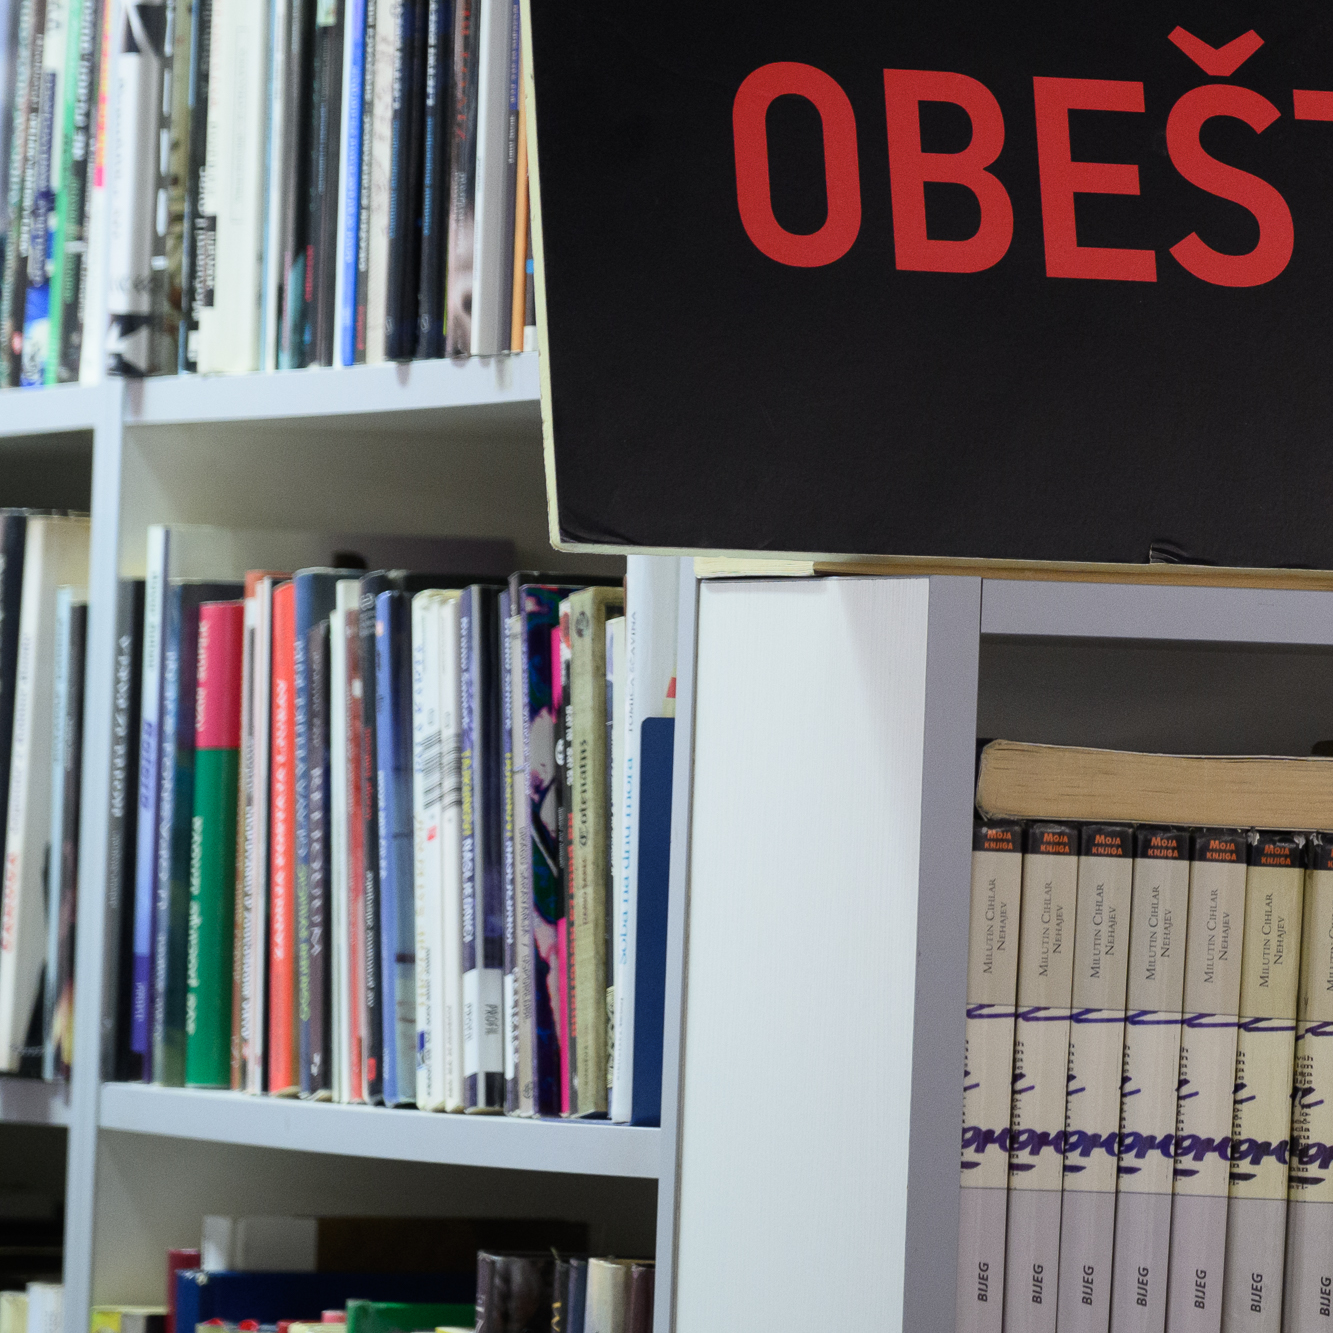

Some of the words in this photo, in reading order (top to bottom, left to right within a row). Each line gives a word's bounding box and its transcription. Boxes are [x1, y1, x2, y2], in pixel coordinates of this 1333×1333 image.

[984, 840, 1013, 850] KNJIGA
[1040, 843, 1070, 853] KNJIGA
[1091, 846, 1123, 856] KNJIGA
[1147, 848, 1179, 858] KNJIGA
[1206, 851, 1237, 861] KNJIGA
[1261, 856, 1291, 865] KNJIGA
[484, 1003, 498, 1036] PROFIL
[977, 1261, 990, 1303] BIJEG
[1031, 1263, 1044, 1305] BIJEG
[1081, 1265, 1094, 1306] BIJEG
[1136, 1266, 1149, 1308] BIJEG
[1194, 1269, 1207, 1310] BIJEG
[1250, 1272, 1263, 1313] BIJEG
[1319, 1275, 1332, 1317] BIJEG
